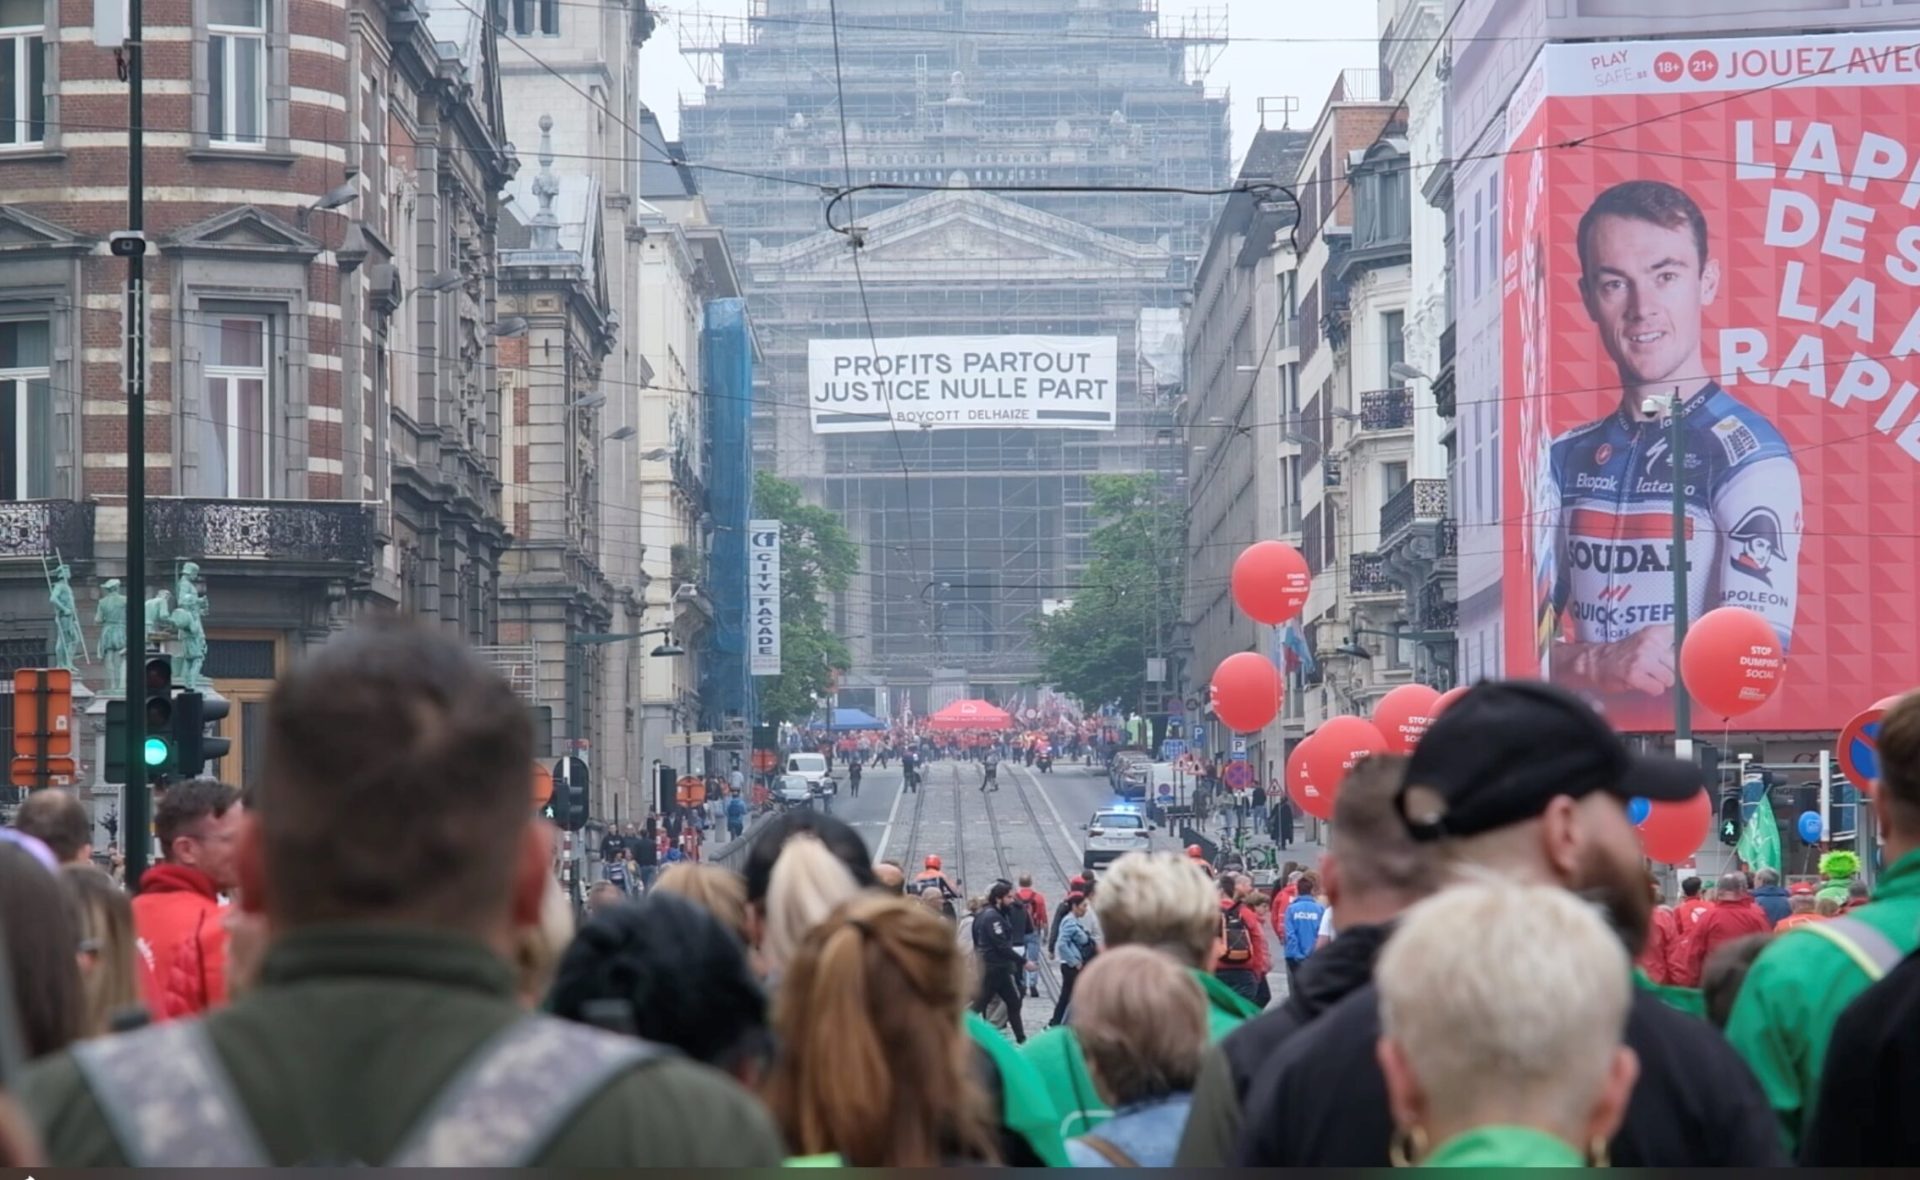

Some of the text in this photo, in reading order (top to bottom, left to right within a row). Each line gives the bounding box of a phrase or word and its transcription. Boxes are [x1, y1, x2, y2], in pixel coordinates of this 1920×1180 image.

[1591, 49, 1628, 70] PLAY
[1658, 61, 1681, 73] 18+
[1693, 60, 1714, 72] 21+
[1726, 47, 1836, 79] JOUEZ
[1764, 188, 1876, 264] DE
[1777, 260, 1876, 343] LA
[834, 351, 1091, 376] PROFITS PARTOUT
[814, 377, 1108, 402] JUSTICE NULLE PART
[896, 409, 1030, 422] BOYCOTT DELHAIZE
[1576, 472, 1619, 492] Ekopak
[1636, 476, 1695, 496] latexo
[757, 552, 773, 592] CITY
[757, 597, 774, 656] FACADE
[1750, 645, 1772, 655] STOP
[1194, 727, 1204, 740] P
[1235, 741, 1243, 751] P
